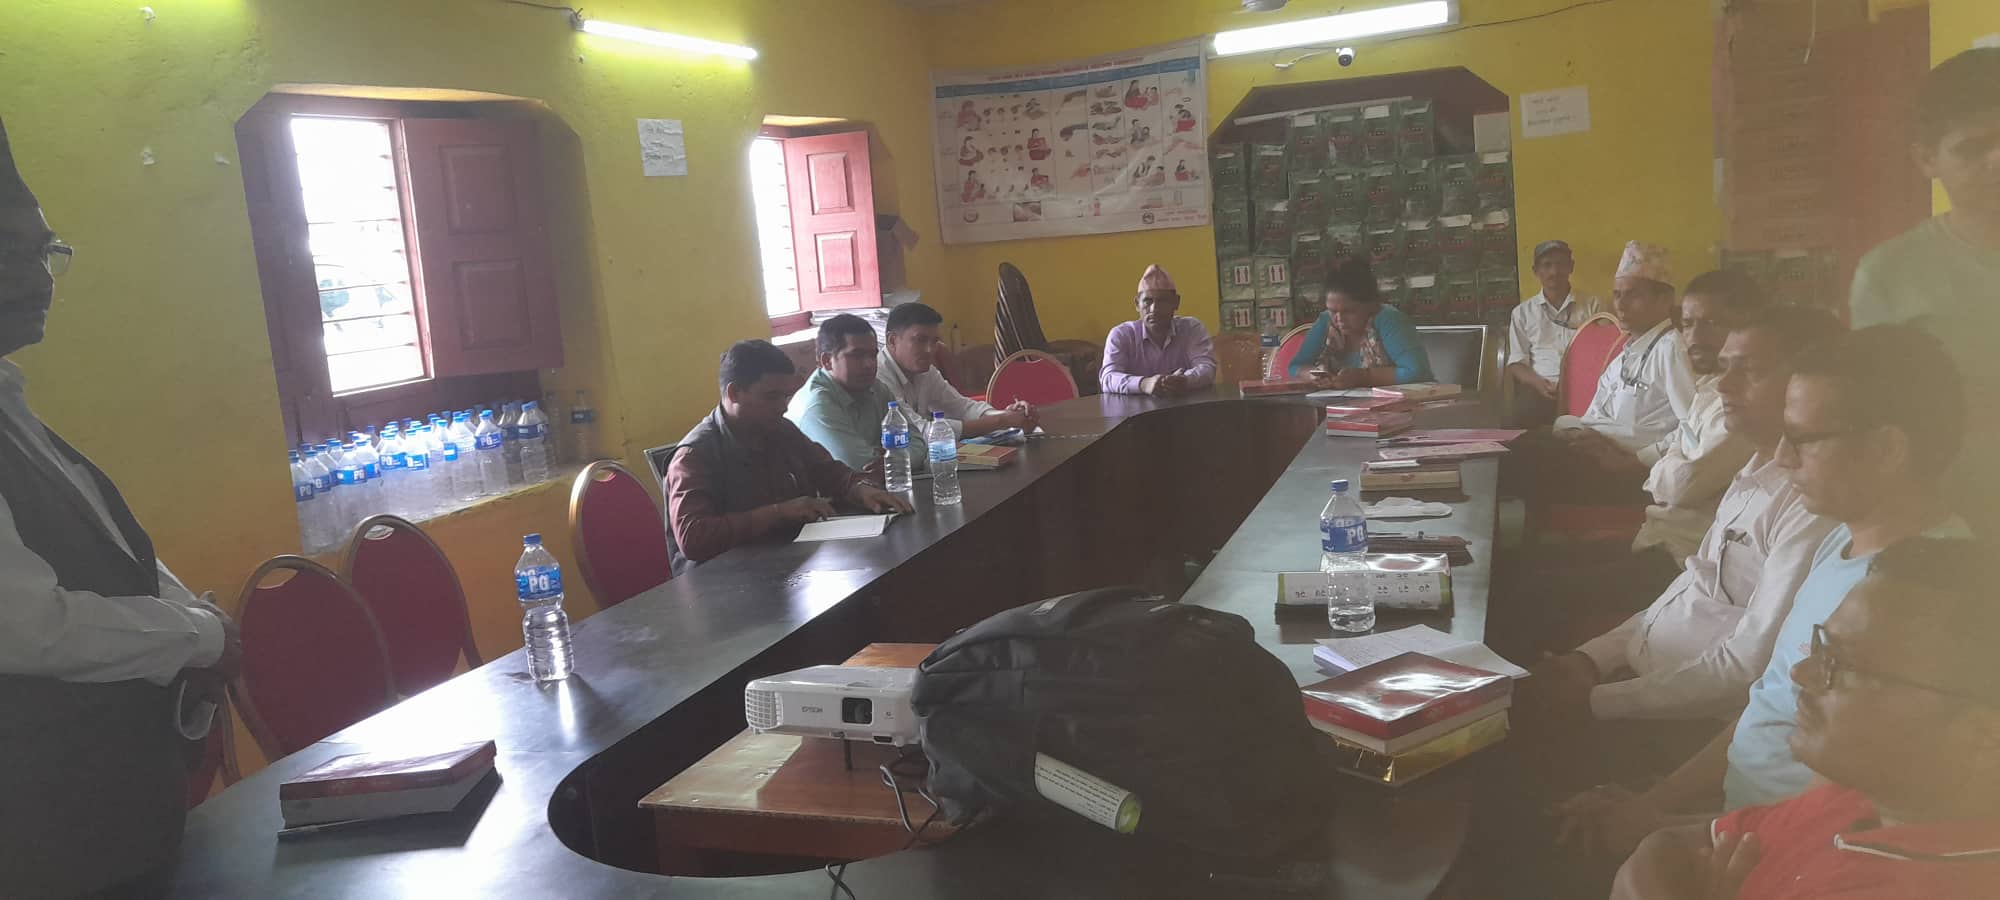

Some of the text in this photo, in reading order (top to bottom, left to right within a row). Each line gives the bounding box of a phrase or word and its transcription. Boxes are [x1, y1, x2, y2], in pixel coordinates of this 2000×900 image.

[480, 436, 493, 447] PG
[895, 435, 906, 445] PG
[353, 470, 365, 480] PG
[299, 484, 312, 497] PG
[1346, 526, 1366, 545] PG
[528, 574, 548, 593] PG
